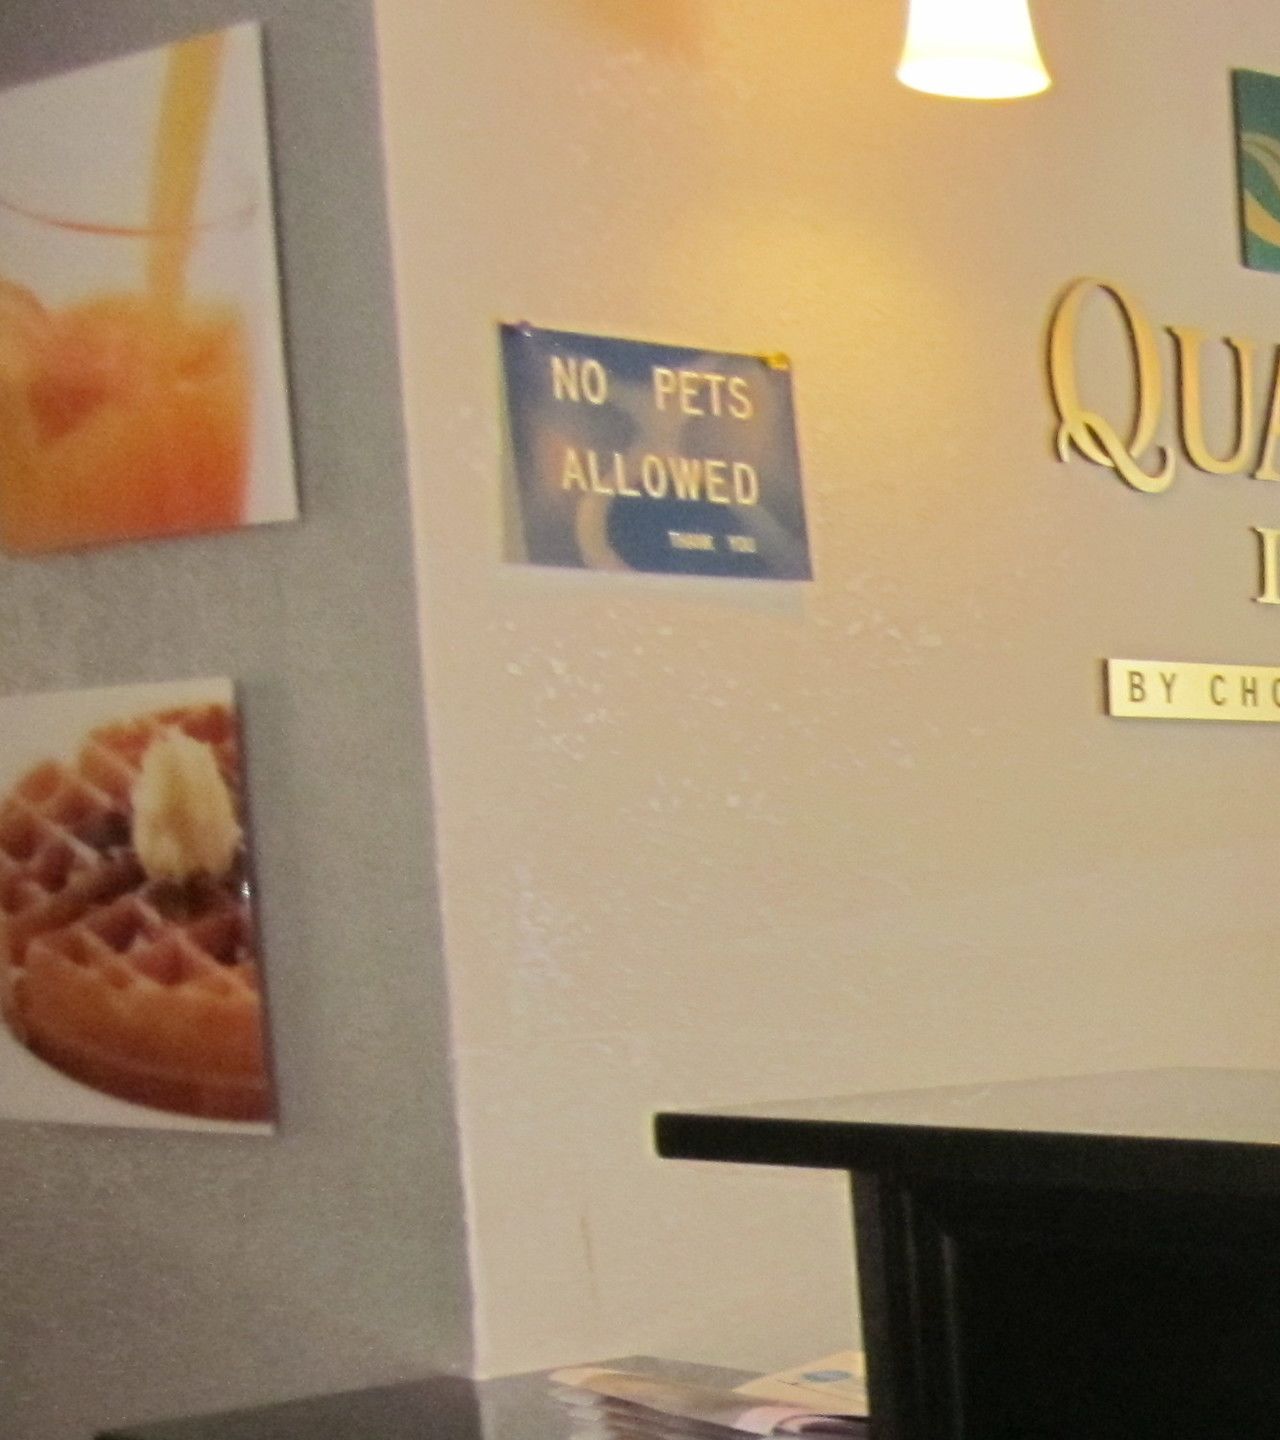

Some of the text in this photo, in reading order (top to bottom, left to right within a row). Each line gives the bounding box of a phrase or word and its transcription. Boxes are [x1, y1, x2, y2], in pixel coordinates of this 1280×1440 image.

[550, 354, 754, 420] NO PETS
[561, 447, 759, 505] ALLOWED
[1127, 670, 1177, 704] BY
